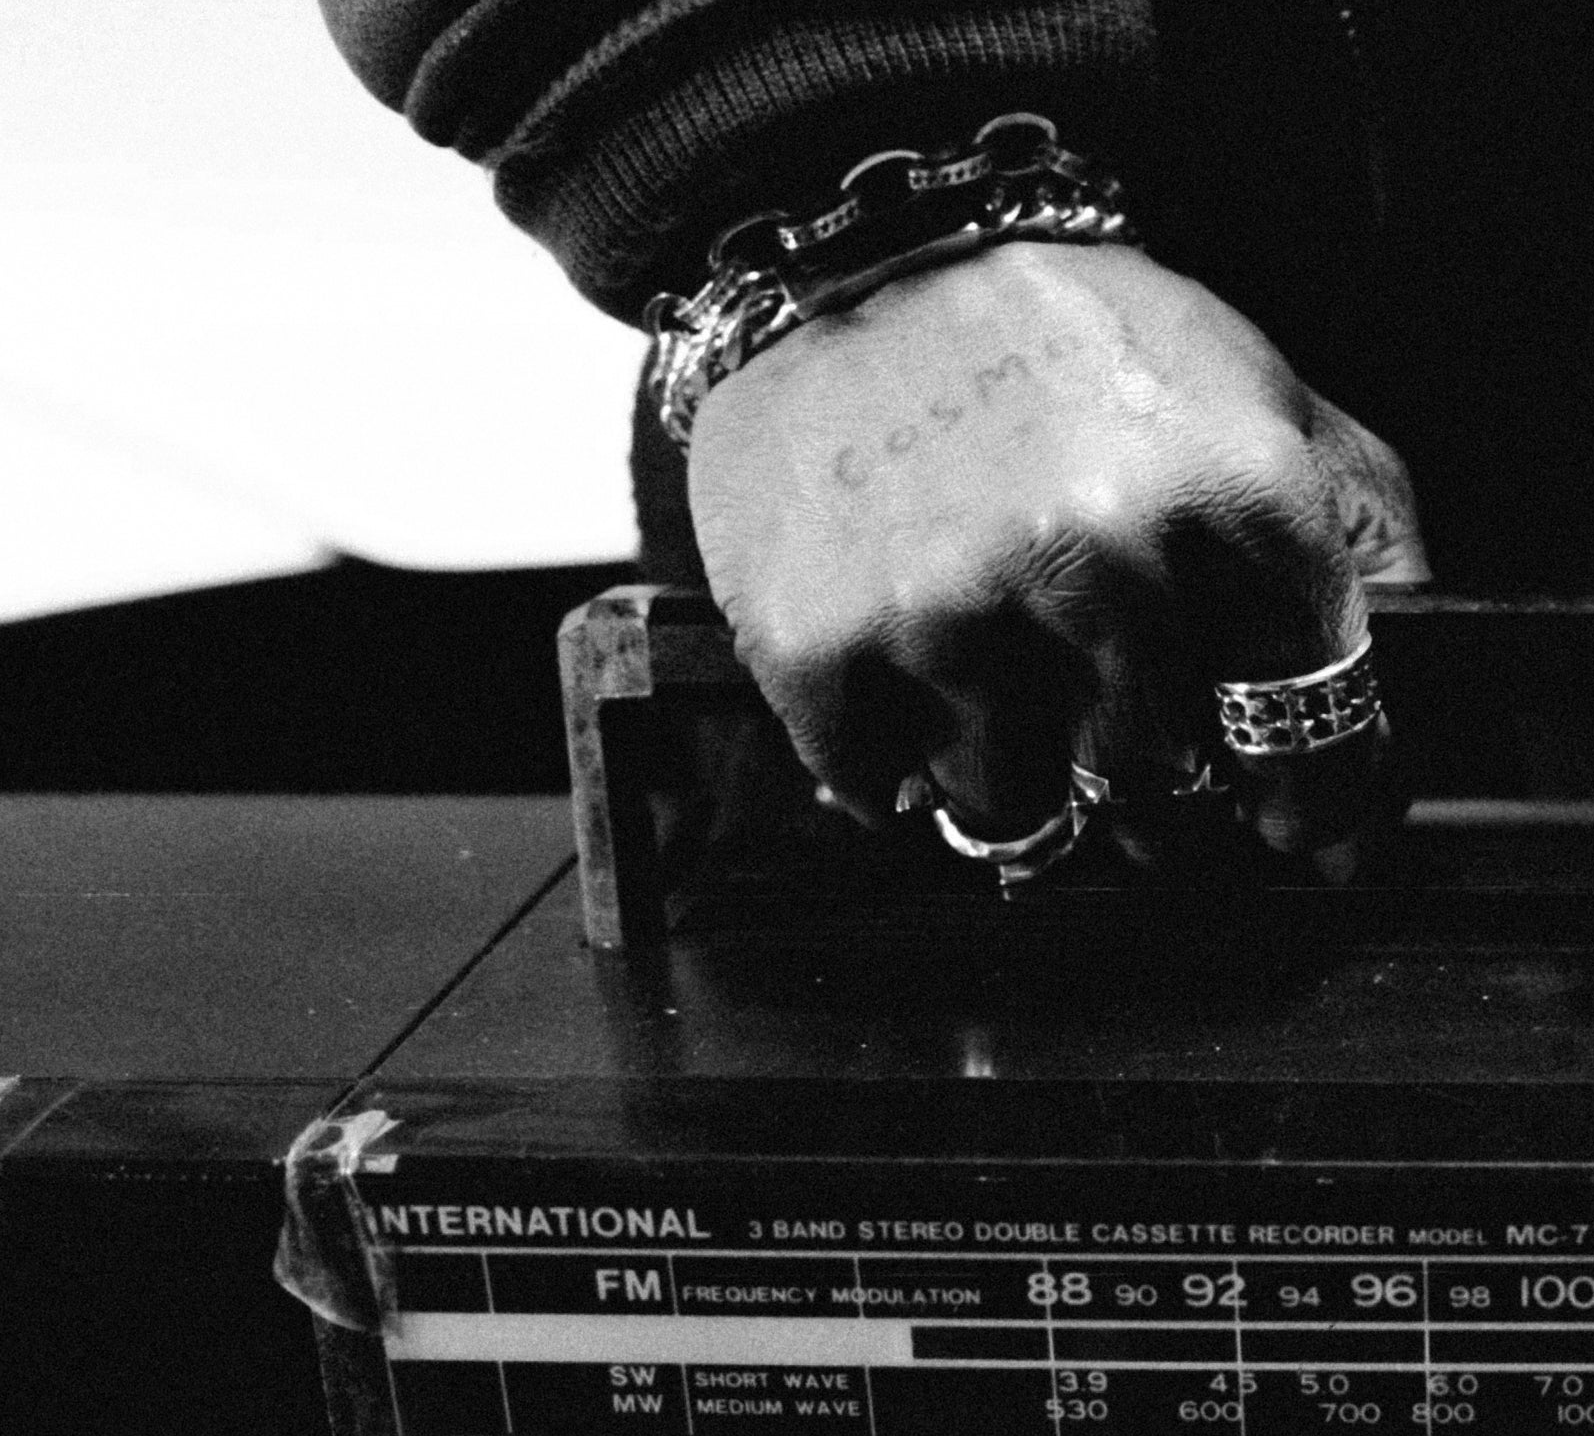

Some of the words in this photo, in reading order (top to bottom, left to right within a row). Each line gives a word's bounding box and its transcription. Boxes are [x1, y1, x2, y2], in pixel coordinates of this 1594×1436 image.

[365, 1204, 712, 1239] INTERNATIONAL
[748, 1220, 764, 1240] 3
[773, 1220, 846, 1241] BAND
[858, 1221, 964, 1242] STEREO
[974, 1222, 1081, 1244] DOUBLE
[1092, 1223, 1237, 1245] CASSETTE
[1248, 1225, 1395, 1246] RECORDER
[1408, 1228, 1488, 1246] MODEL
[596, 1268, 663, 1303] FM
[683, 1284, 817, 1304] FREQUENCY
[831, 1286, 982, 1307] MODULATION
[1026, 1271, 1093, 1307] 88
[1114, 1285, 1158, 1307] 90
[1181, 1273, 1248, 1308] 92
[1279, 1286, 1322, 1308] 94
[1350, 1274, 1417, 1309] 96
[1448, 1286, 1492, 1309] 98
[609, 1365, 657, 1388] SW
[694, 1371, 770, 1390] SHORT
[783, 1372, 851, 1391] WAVE
[612, 1393, 664, 1415] MW
[697, 1398, 784, 1416] MEDIUM
[795, 1399, 863, 1418] WAVE
[1044, 1399, 1109, 1421] 530
[1178, 1400, 1243, 1422] 600
[1318, 1403, 1382, 1424] 700
[1411, 1402, 1476, 1424] 800
